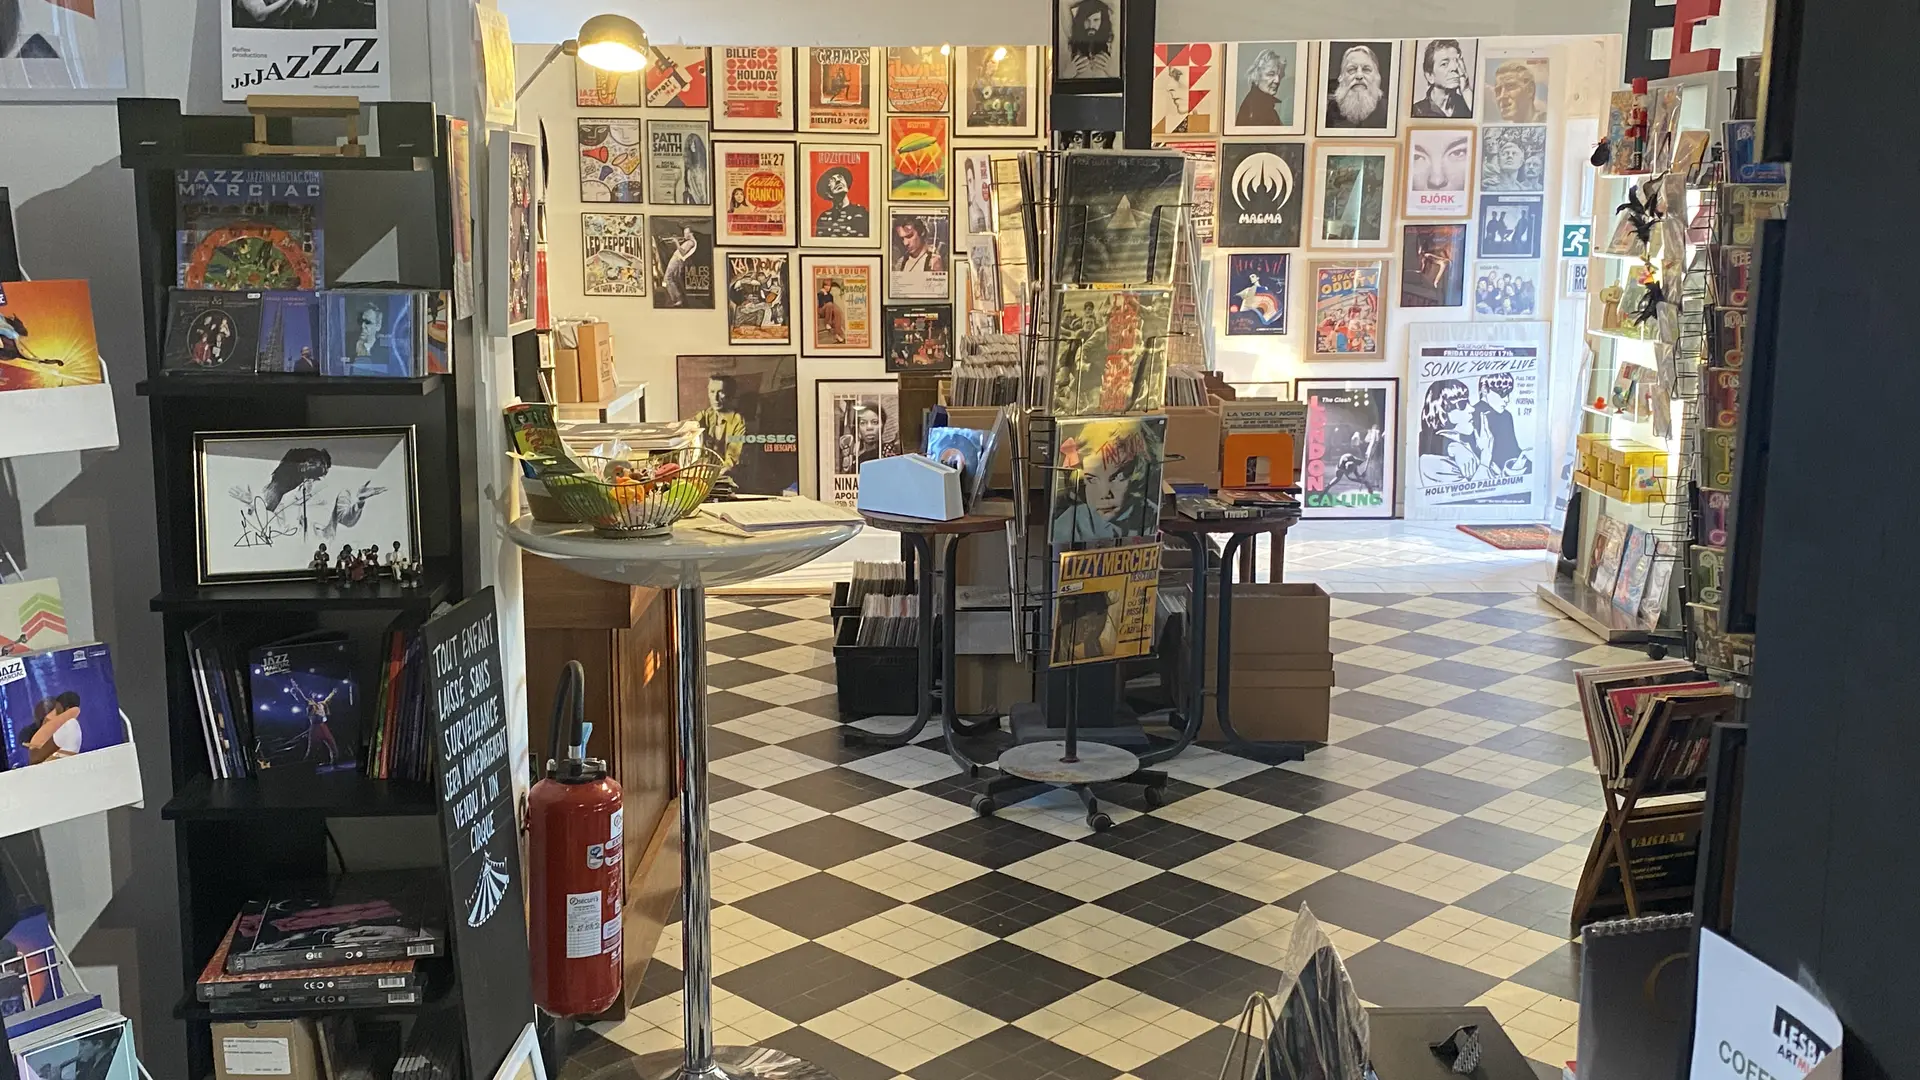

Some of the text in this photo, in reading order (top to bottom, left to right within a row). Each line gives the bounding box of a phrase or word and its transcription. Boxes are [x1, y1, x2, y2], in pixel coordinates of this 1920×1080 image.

[726, 48, 757, 59] BILLIE
[817, 47, 870, 65] CRAMPS
[737, 70, 778, 80] HOLIDAY
[811, 117, 842, 125] BIELEFELD
[652, 132, 682, 143] PATTI
[652, 143, 683, 153] SMITH
[773, 153, 784, 166] 27
[177, 170, 244, 183] JAZZ
[178, 184, 320, 197] MARCIAC
[747, 187, 784, 202] FRANKLIN
[1238, 212, 1283, 224] MAGMA
[585, 236, 642, 260] LED ZEPPELIN
[685, 265, 710, 276] MILES
[685, 276, 710, 287] DAVIS
[1421, 358, 1537, 378] SONIC YOUTH LIVE
[835, 477, 859, 491] NINA
[1425, 482, 1477, 497] HOLLYWOOD
[1477, 476, 1524, 489] PALLADIUM
[1308, 493, 1384, 507] CALLING
[1063, 547, 1159, 580] LIZZY MERCIER
[432, 612, 493, 678] TOUT ENFANT
[437, 658, 491, 722] LAISSÉ SANS
[444, 695, 499, 761] SURVEILLANCE
[445, 764, 463, 801] SERA
[453, 788, 479, 830] VENDU
[488, 771, 500, 802] UN
[469, 809, 496, 854] CIRQUE
